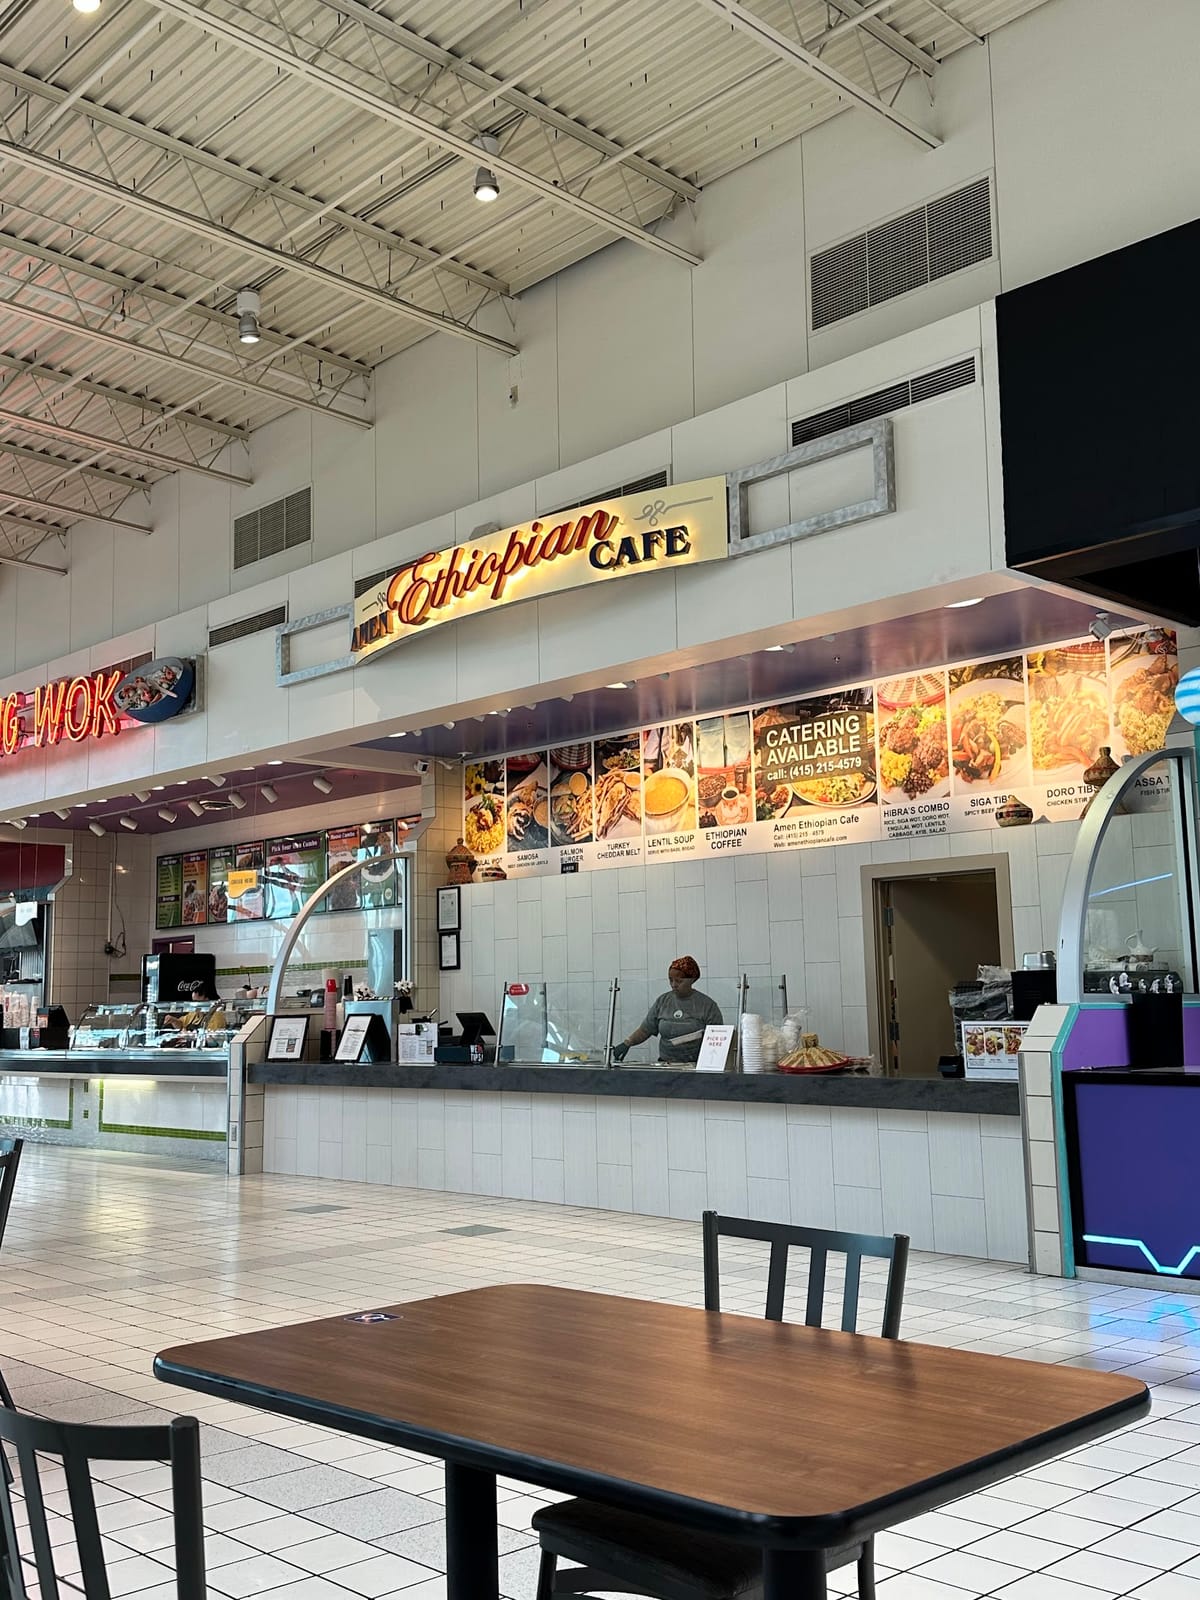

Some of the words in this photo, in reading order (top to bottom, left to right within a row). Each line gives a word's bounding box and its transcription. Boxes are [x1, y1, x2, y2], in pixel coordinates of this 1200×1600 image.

[589, 525, 692, 571] CAFE
[386, 509, 619, 626] Ethiopian
[350, 610, 394, 652] AMEN
[0, 691, 25, 756] G
[34, 670, 124, 748] WOK
[766, 715, 860, 748] CATERING
[766, 734, 861, 766] AVAILABLE
[767, 768, 787, 781] call:
[789, 763, 814, 780] (415)
[816, 756, 862, 774] 215-4579
[1134, 776, 1163, 788] ASSA
[1046, 786, 1075, 799] DORO
[1140, 788, 1155, 796] FISH
[970, 797, 992, 807] SIGA
[1046, 799, 1073, 807] CHICKEN
[883, 805, 916, 818] HIBRA'S
[918, 802, 950, 814] COMBO
[964, 809, 980, 817] SPICY
[981, 807, 995, 815] BEEF
[773, 823, 797, 833] Amen
[799, 816, 838, 830] Ethiopian
[840, 814, 860, 826] Cafe
[647, 837, 671, 848] LENTIL
[673, 834, 695, 844] SOUP
[705, 828, 748, 841] ETHIOPIAN
[607, 842, 631, 851] TURKEY
[711, 838, 742, 850] COFFEE
[516, 853, 539, 862] SAMOSA
[560, 848, 584, 856] SALMON
[597, 850, 625, 860] CHEDDAR
[625, 848, 641, 857] MELT
